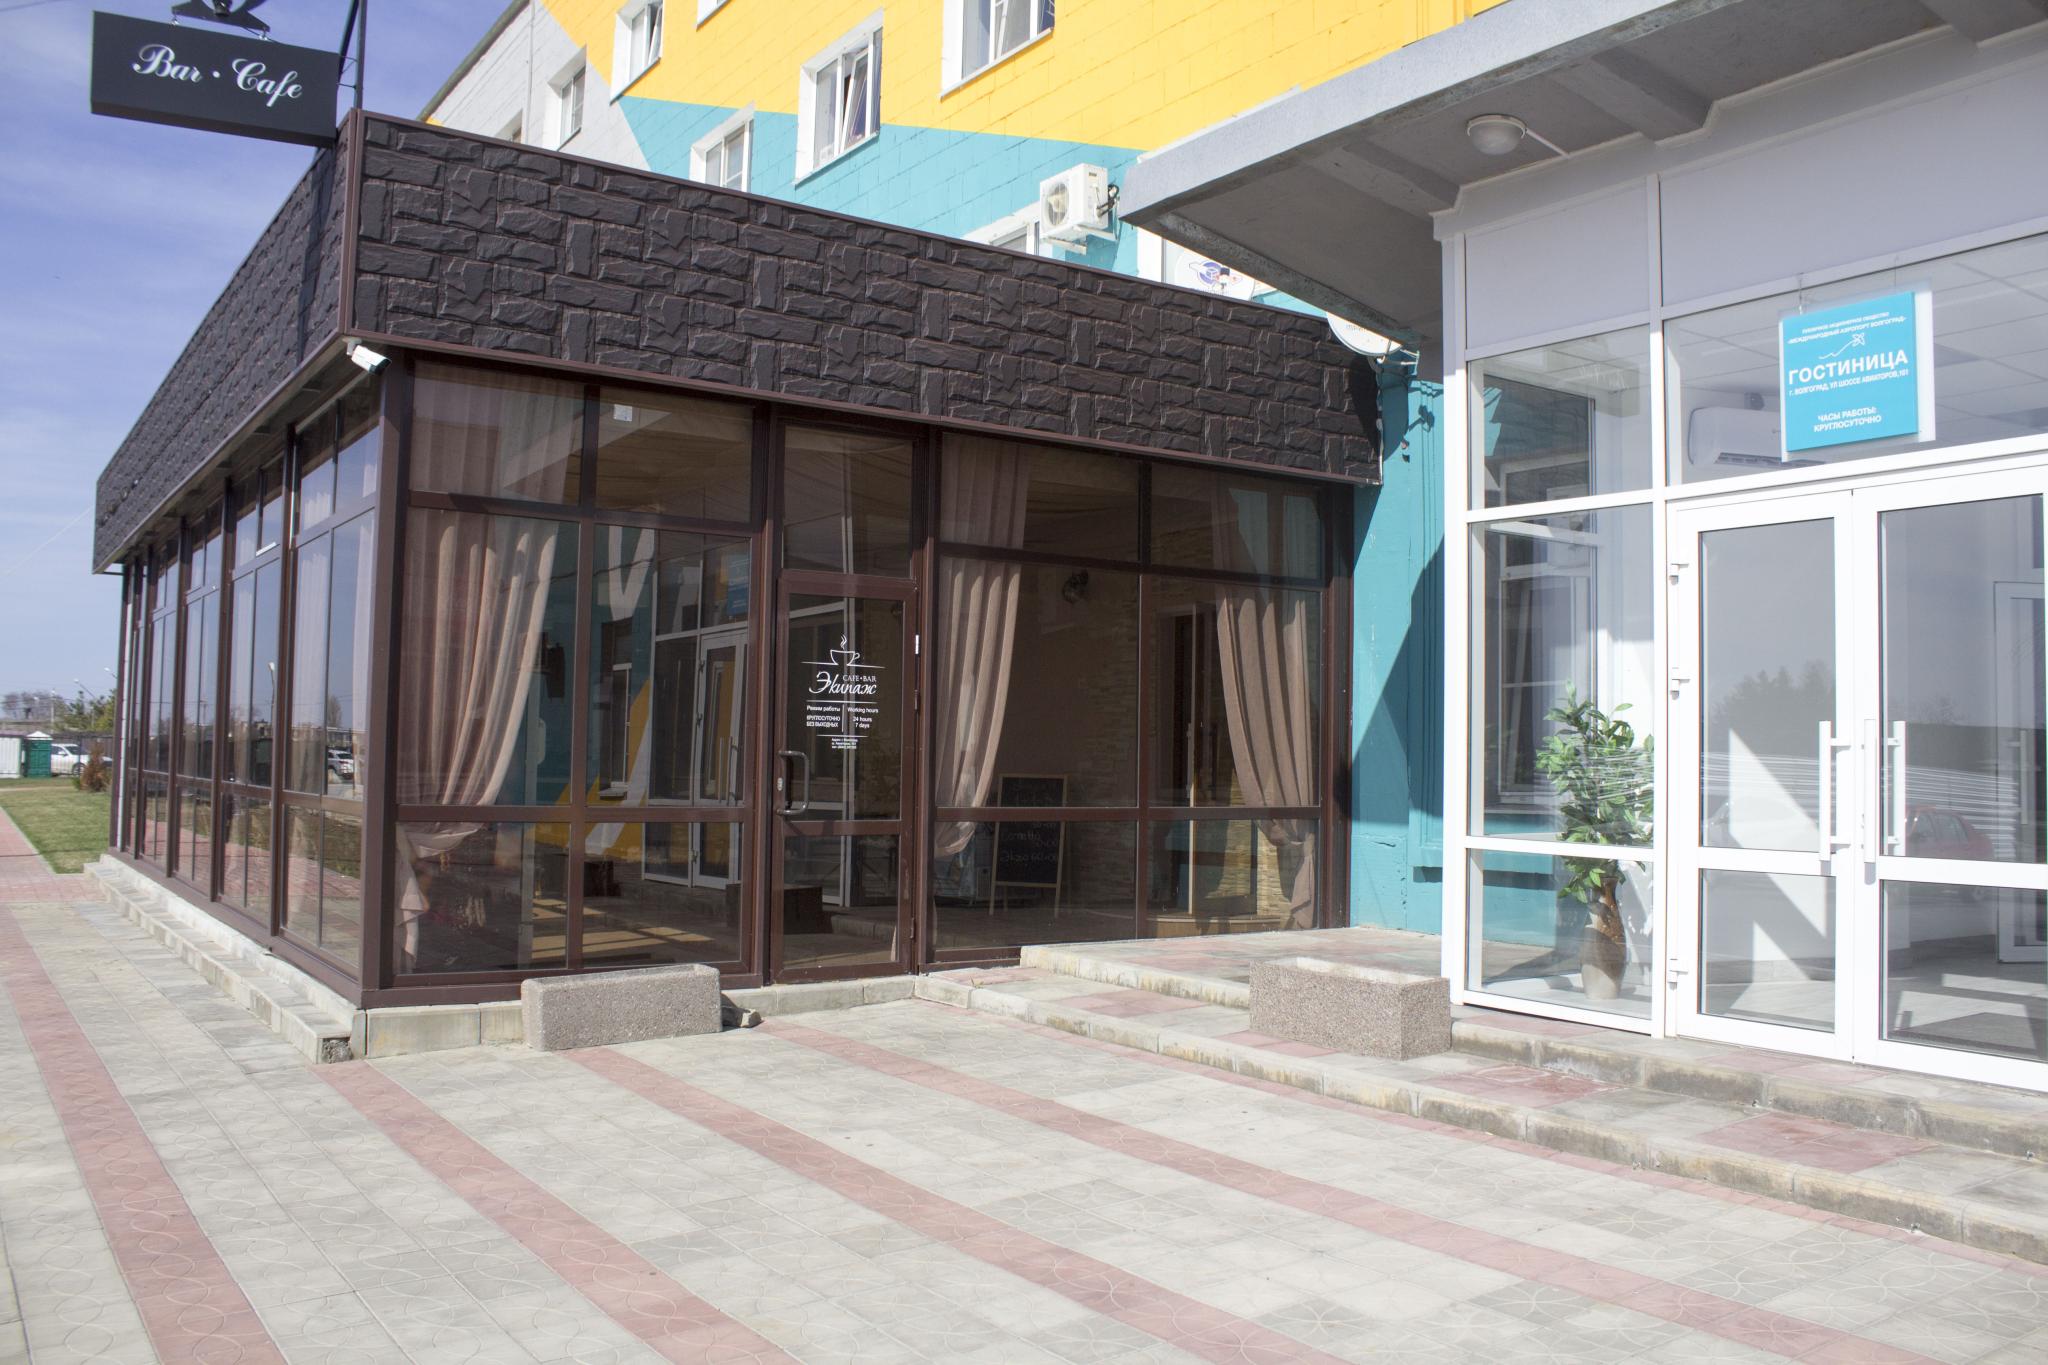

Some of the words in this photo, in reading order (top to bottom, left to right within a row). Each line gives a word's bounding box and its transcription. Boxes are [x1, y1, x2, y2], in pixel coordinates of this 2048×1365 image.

[132, 44, 202, 83] Bar
[231, 58, 302, 107] Cafe
[1788, 349, 1908, 385] ГОСТИНИЦА
[1814, 415, 1882, 432] КРУГЛОСУТОЧНО
[1818, 412, 1840, 422] ЧАСЫ
[809, 671, 877, 694] Экипаж
